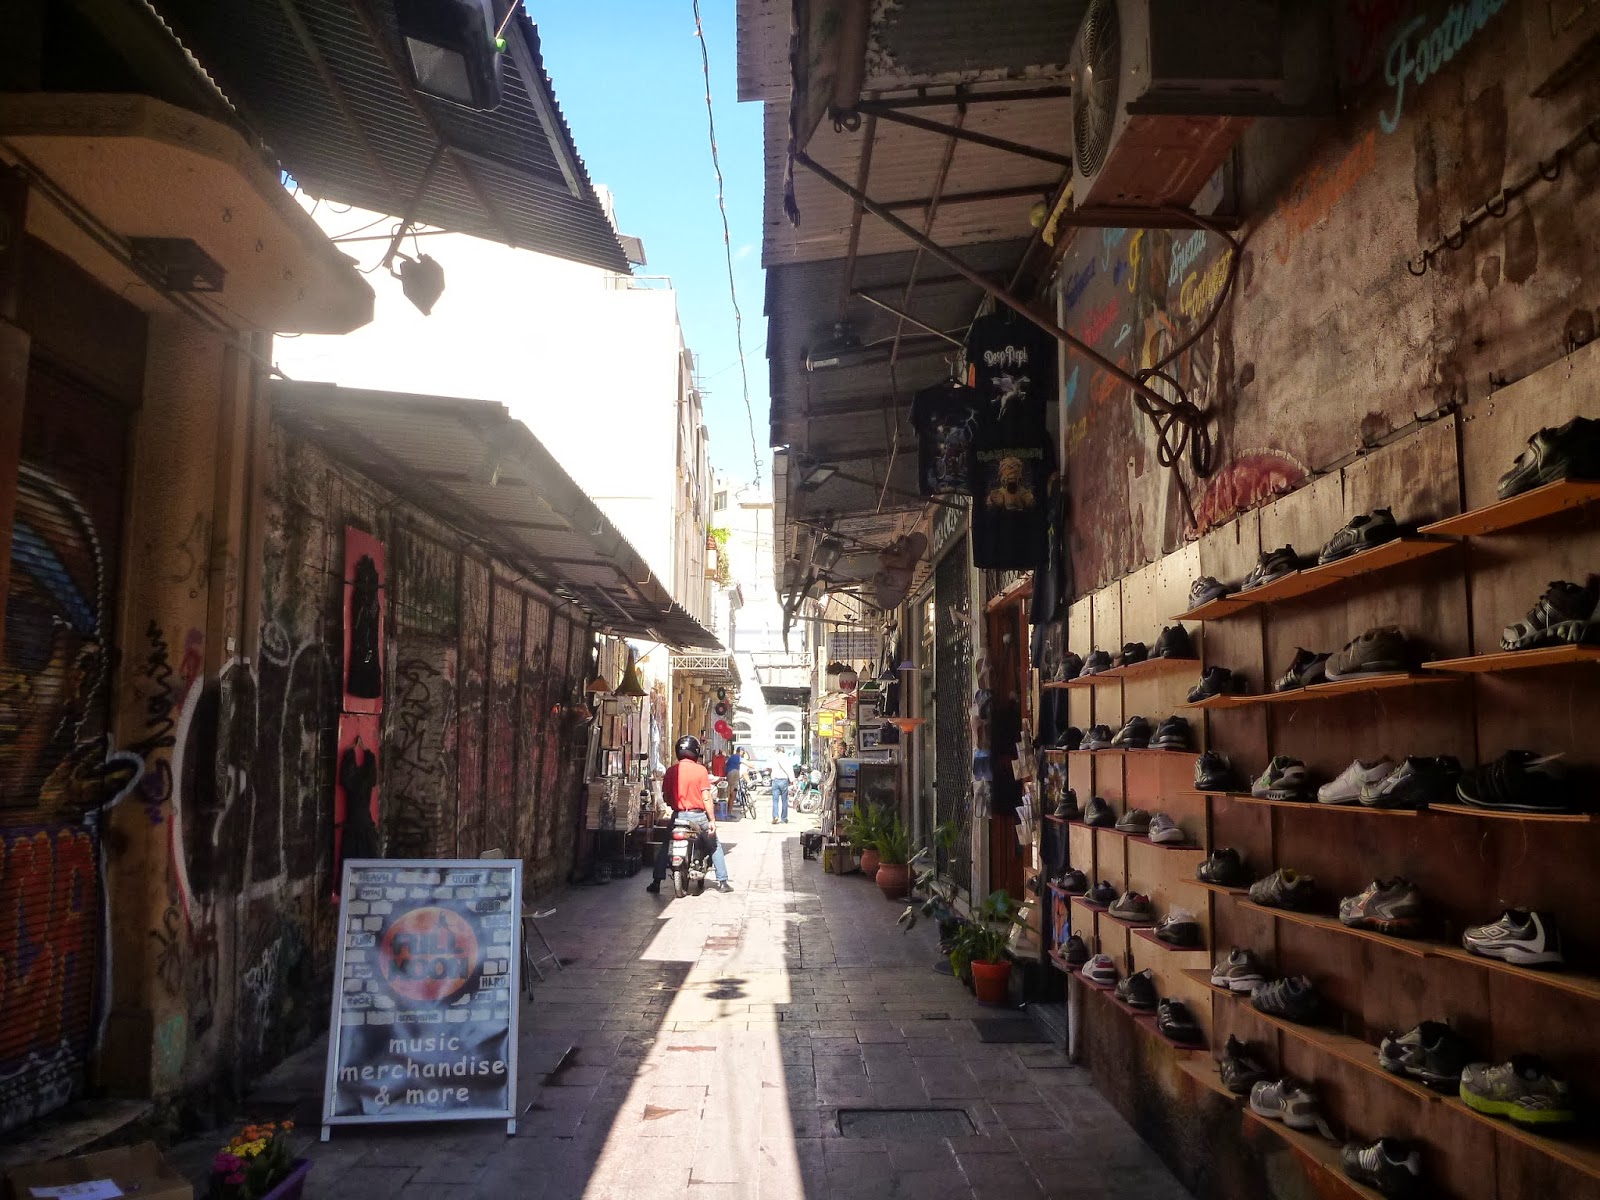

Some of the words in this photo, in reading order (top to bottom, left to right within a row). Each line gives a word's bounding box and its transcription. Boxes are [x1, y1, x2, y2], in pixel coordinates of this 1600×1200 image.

[983, 350, 1006, 369] Deep
[392, 932, 464, 956] FULL
[389, 957, 469, 980] MOON
[482, 977, 506, 987] HARD
[389, 1032, 460, 1054] music
[339, 1055, 506, 1082] merchandise
[374, 1084, 391, 1106] &
[406, 1086, 470, 1105] more
